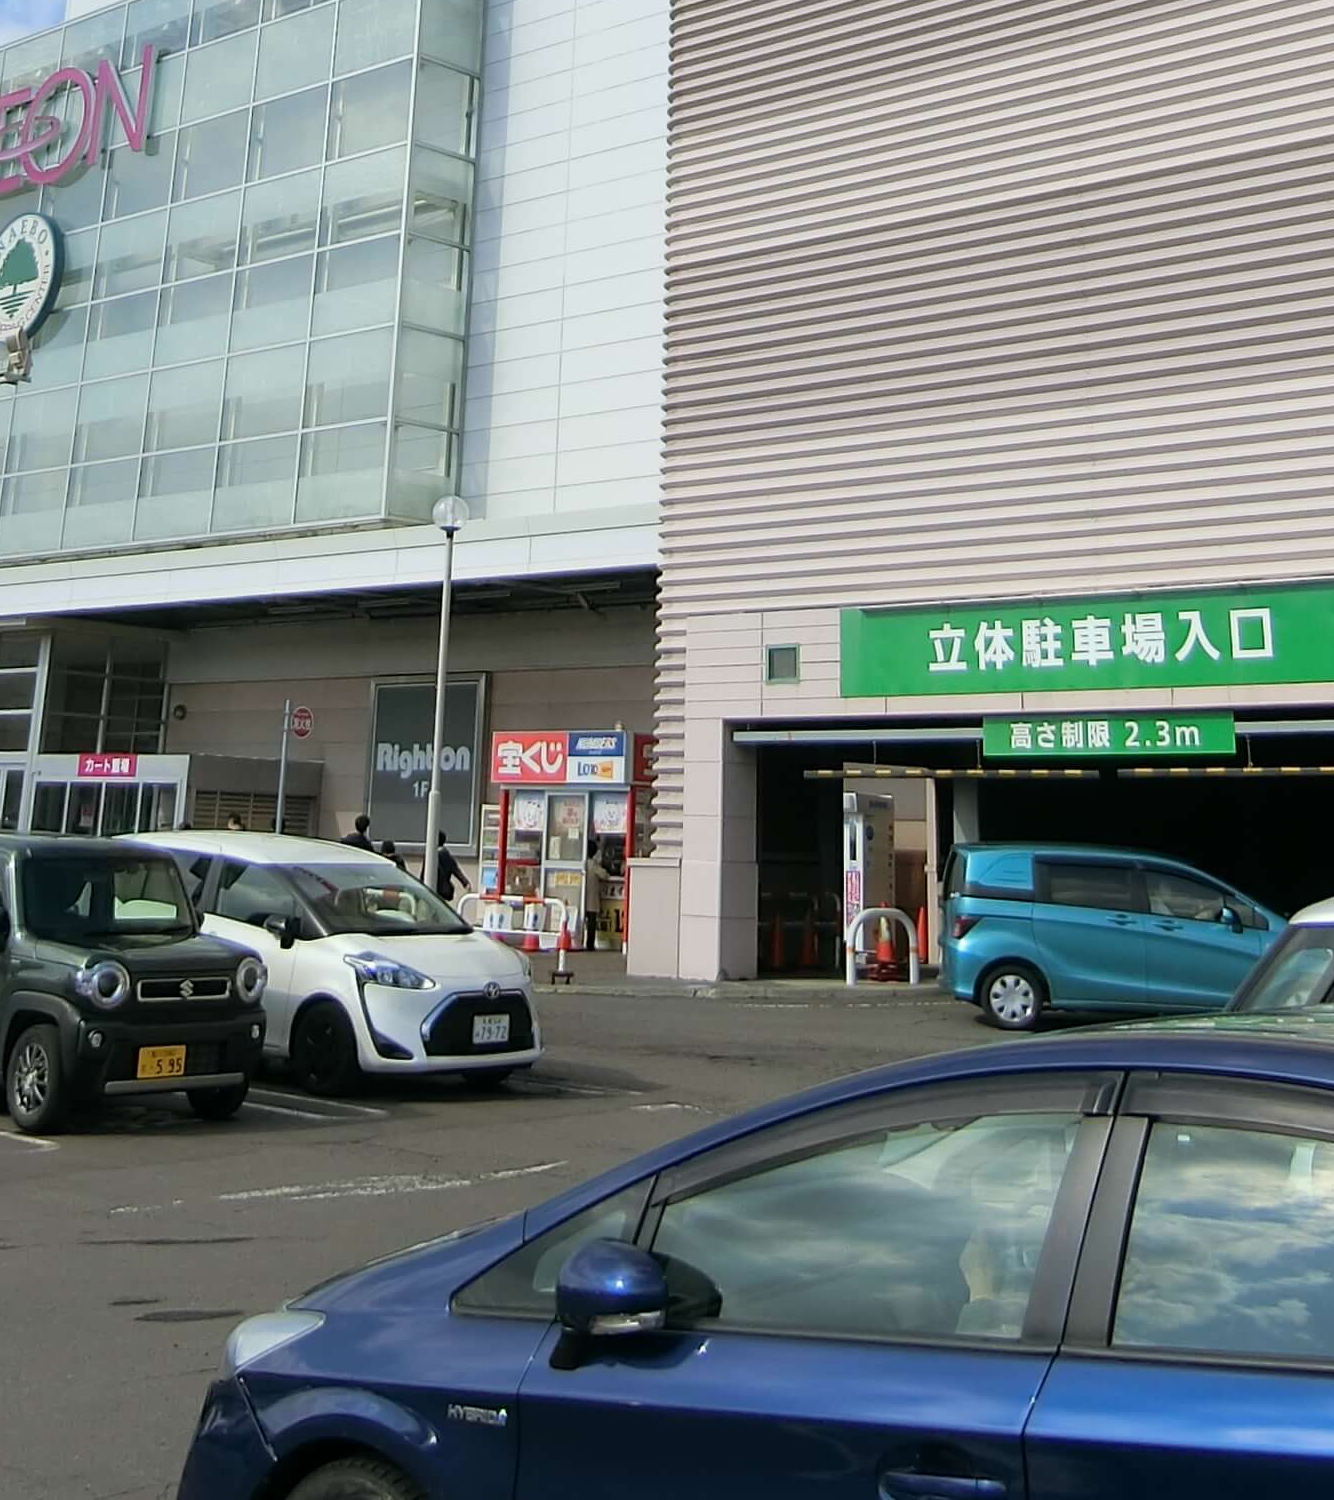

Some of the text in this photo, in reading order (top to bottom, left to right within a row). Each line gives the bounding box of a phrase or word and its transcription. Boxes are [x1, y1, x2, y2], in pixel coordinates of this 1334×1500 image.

[928, 607, 1274, 672] 立体駐車場入口
[1009, 720, 1201, 750] 高さ制限 2.3m
[497, 739, 564, 775] 宝くじ
